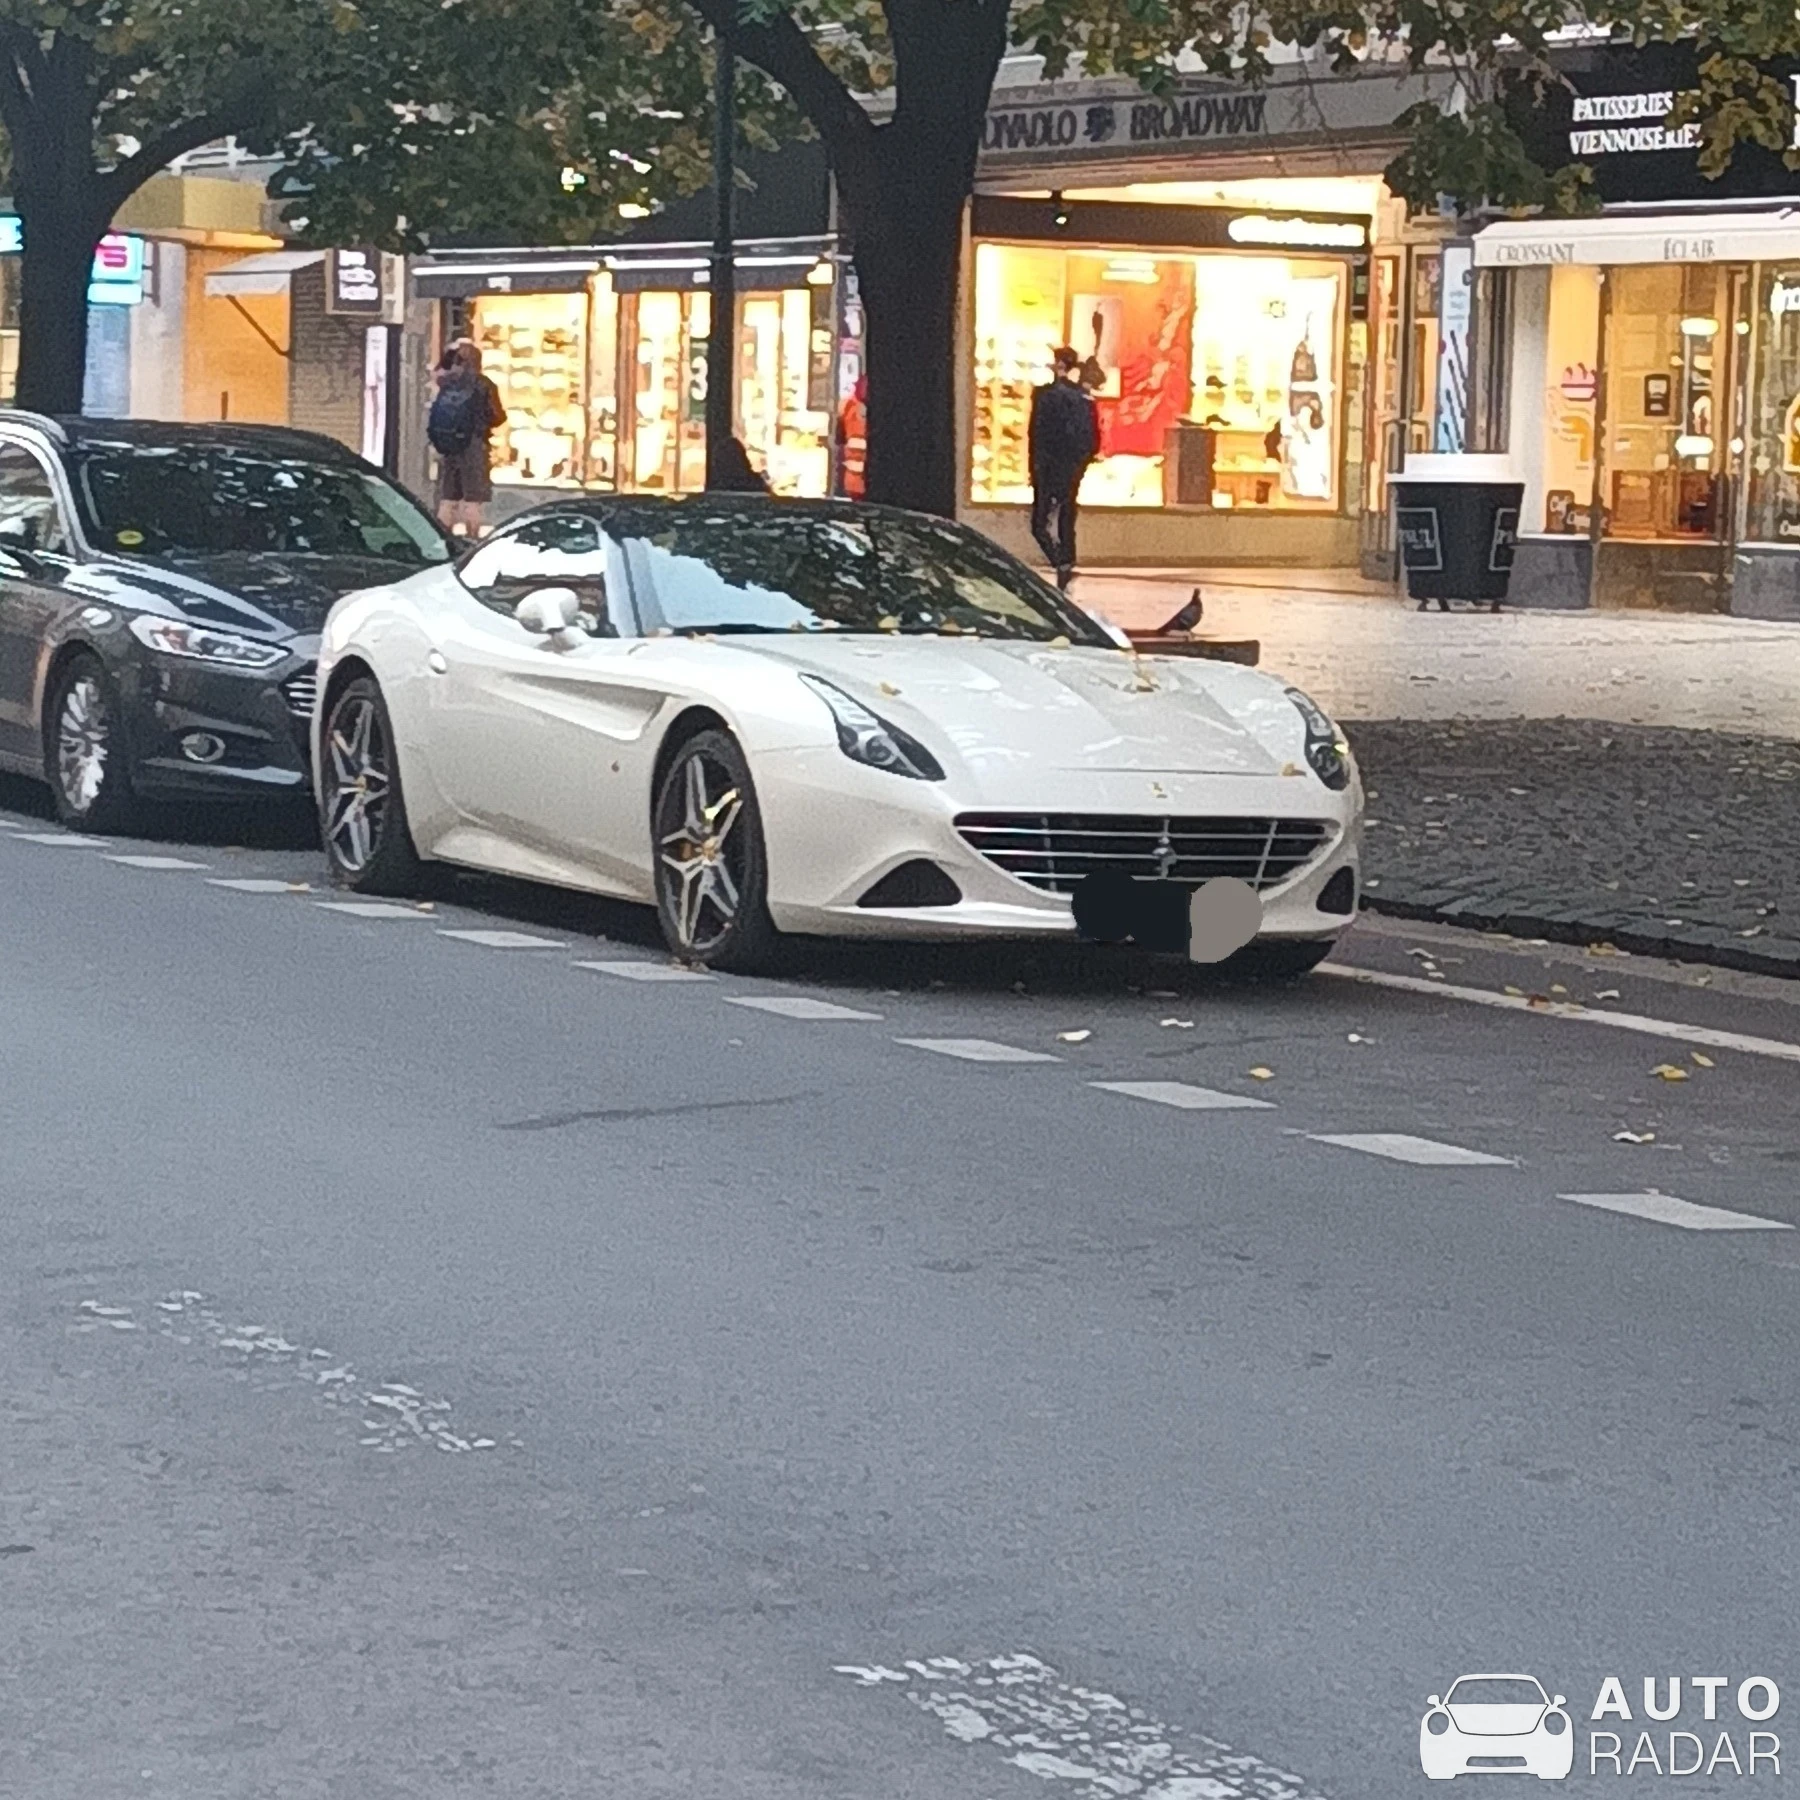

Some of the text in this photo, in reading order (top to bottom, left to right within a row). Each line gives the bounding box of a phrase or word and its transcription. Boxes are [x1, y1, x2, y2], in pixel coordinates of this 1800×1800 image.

[1130, 95, 1267, 140] BROADWAY
[1570, 123, 1702, 154] VIENNOISERIE
[1496, 243, 1575, 263] CROISSANT
